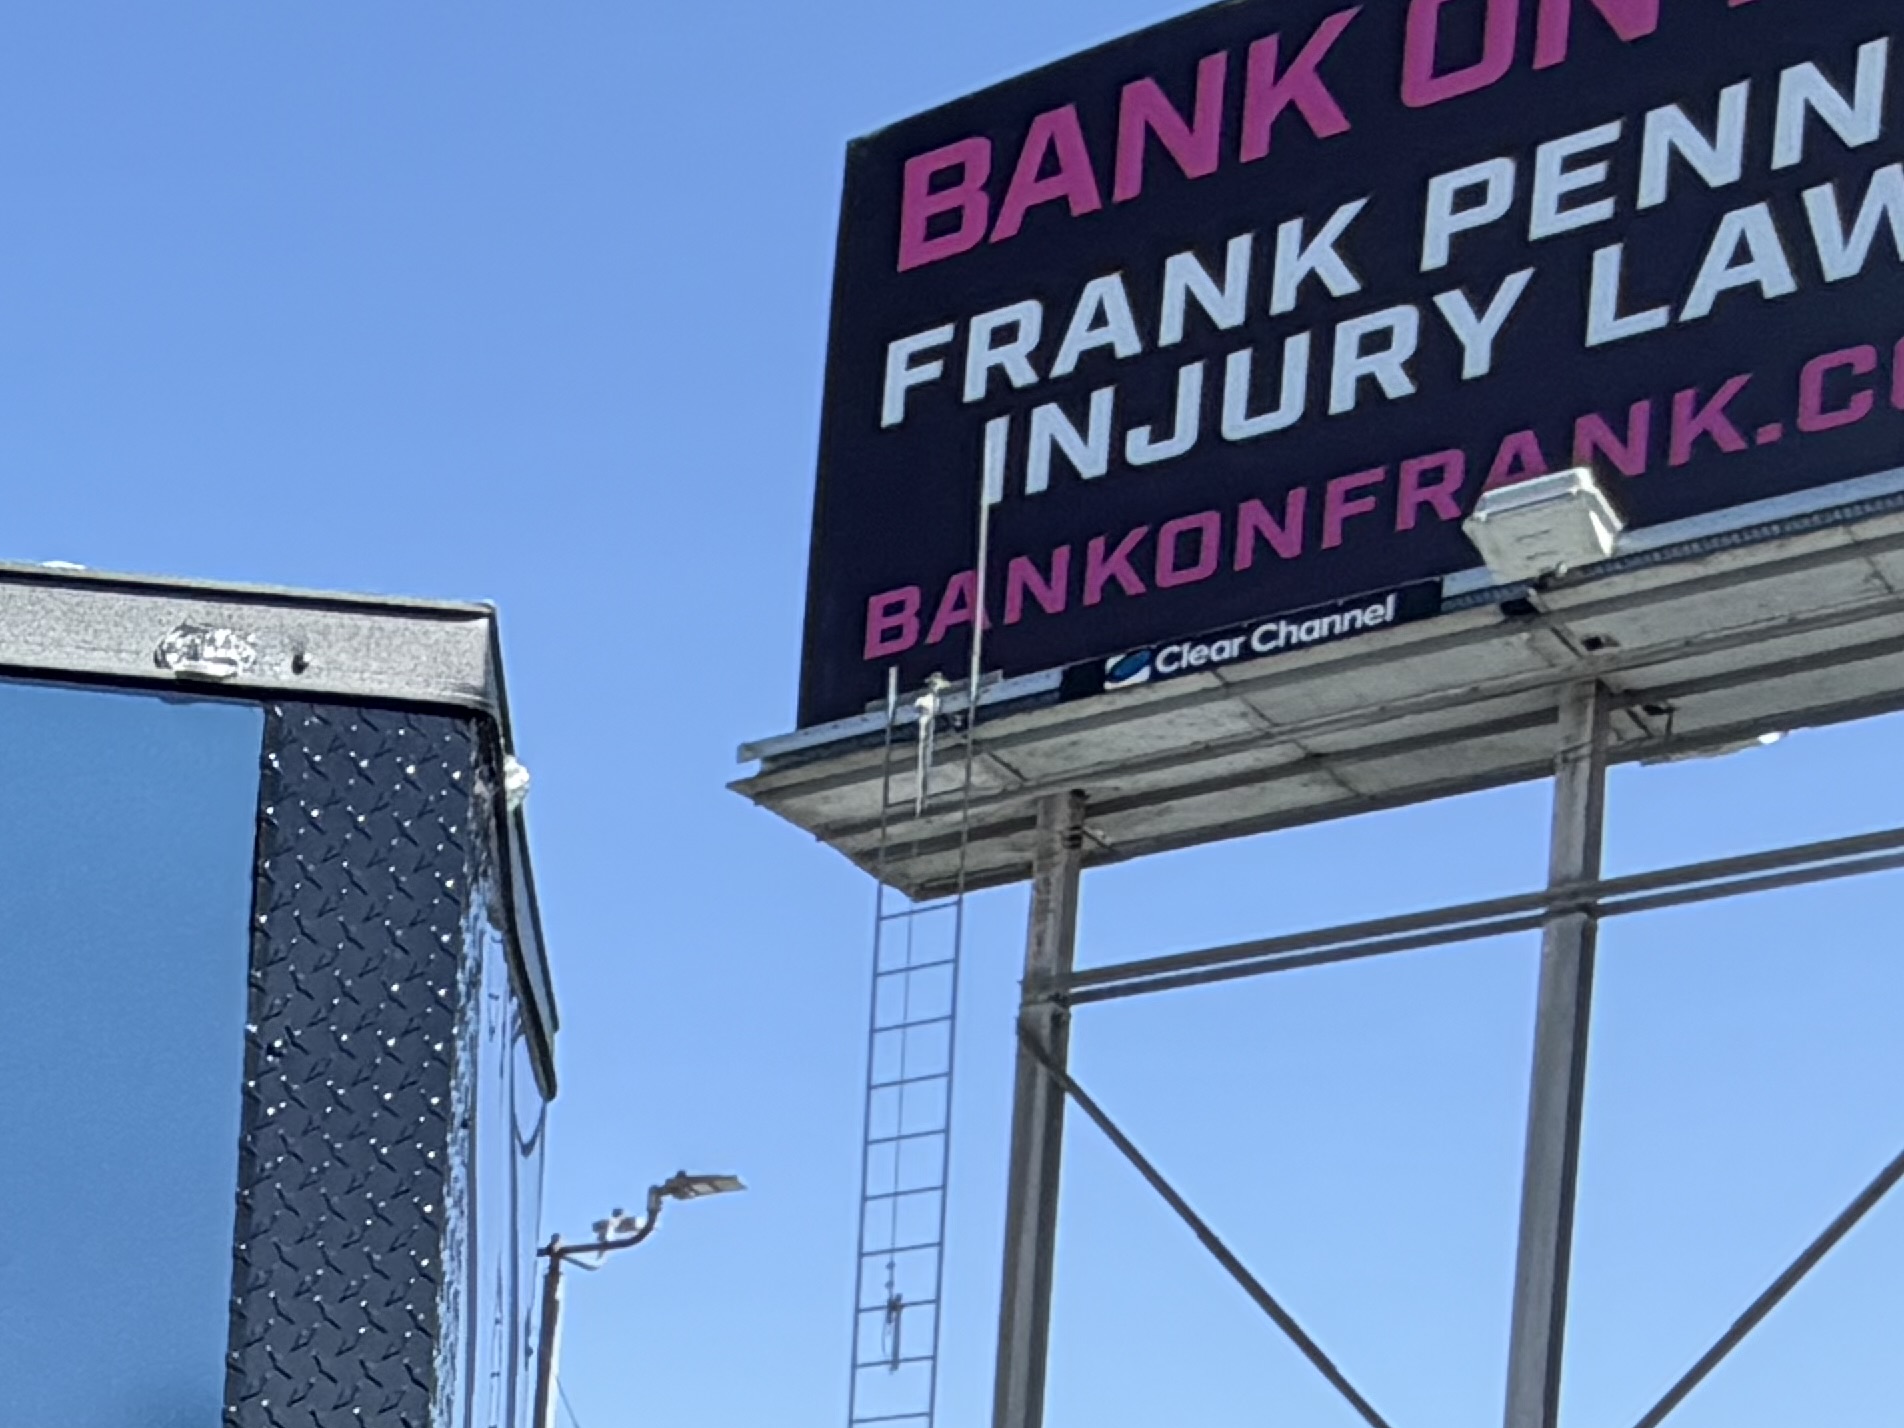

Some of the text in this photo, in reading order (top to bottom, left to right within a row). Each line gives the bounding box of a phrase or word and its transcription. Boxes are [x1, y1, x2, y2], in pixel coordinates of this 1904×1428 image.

[881, 36, 1889, 428] FRANK PENN
[897, 5, 1365, 273] BANK
[981, 162, 1904, 507] INJURY LAW
[863, 336, 1904, 660] BANKONFRANK.C
[1155, 593, 1397, 674] Clear Channel
